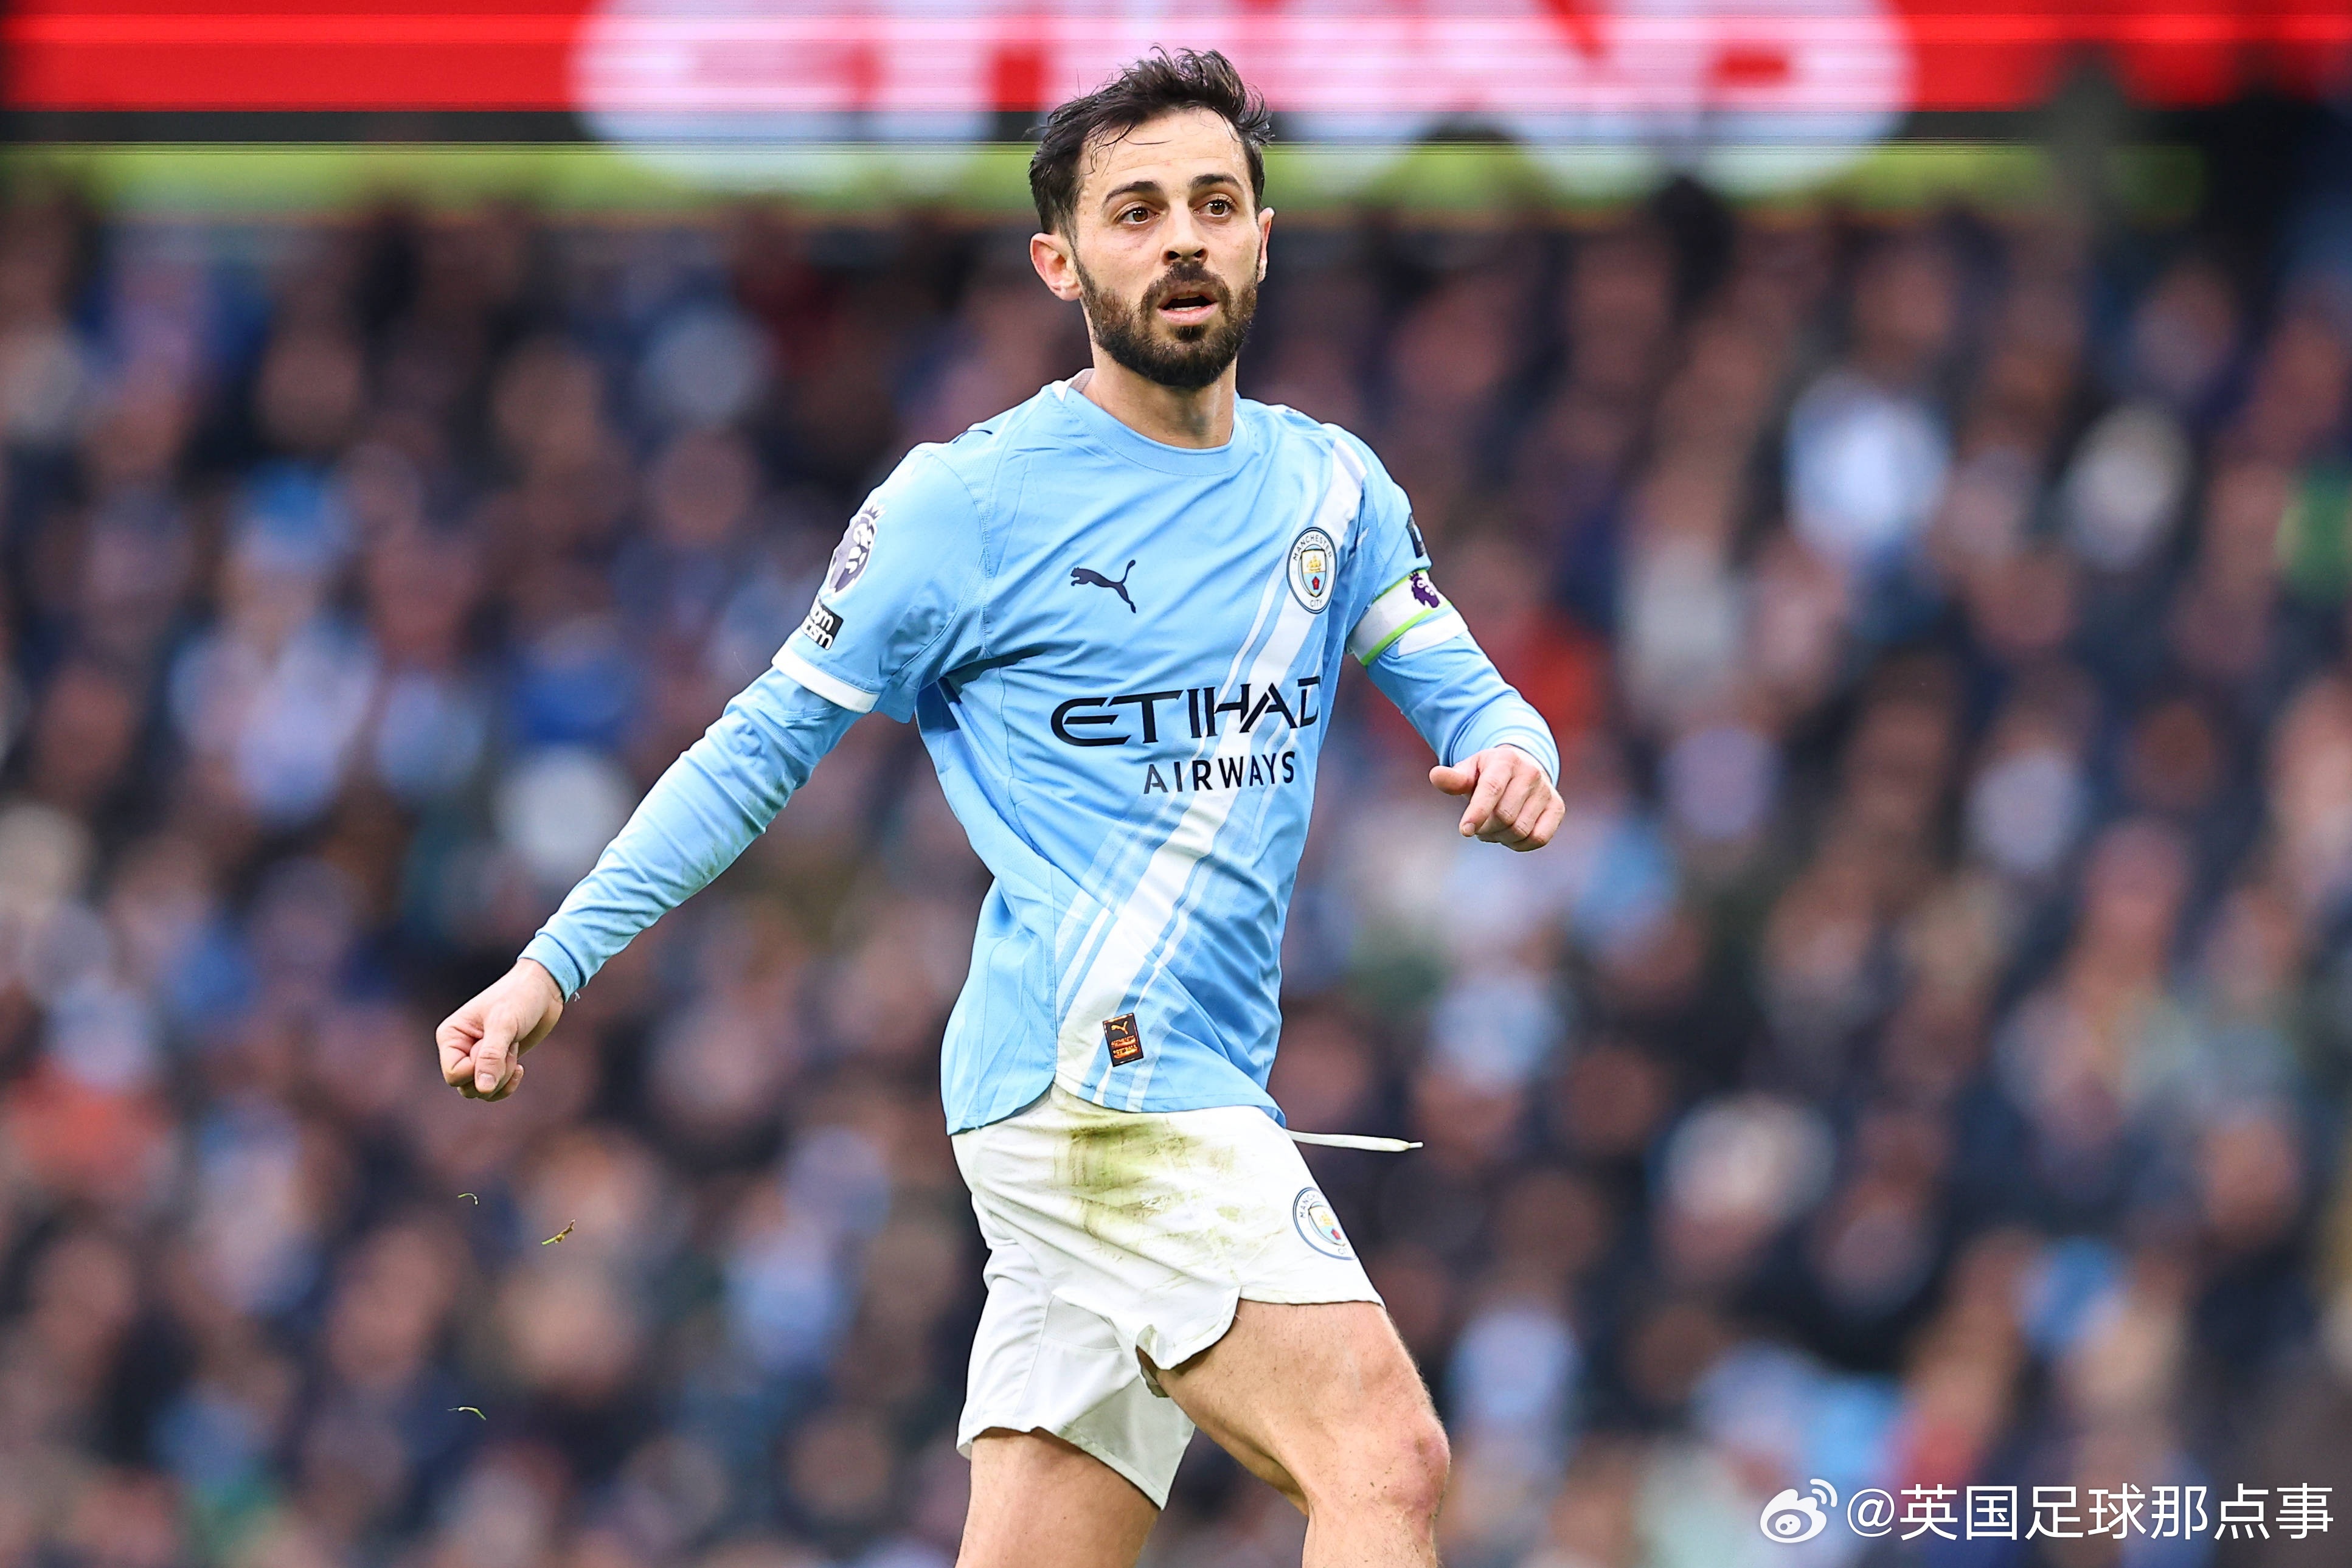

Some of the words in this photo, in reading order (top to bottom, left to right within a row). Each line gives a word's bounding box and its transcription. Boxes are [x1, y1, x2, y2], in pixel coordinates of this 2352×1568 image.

[1292, 534, 1332, 561] MANCHESTER
[1310, 598, 1323, 608] CITY
[1143, 751, 1295, 794] AIRWAYS
